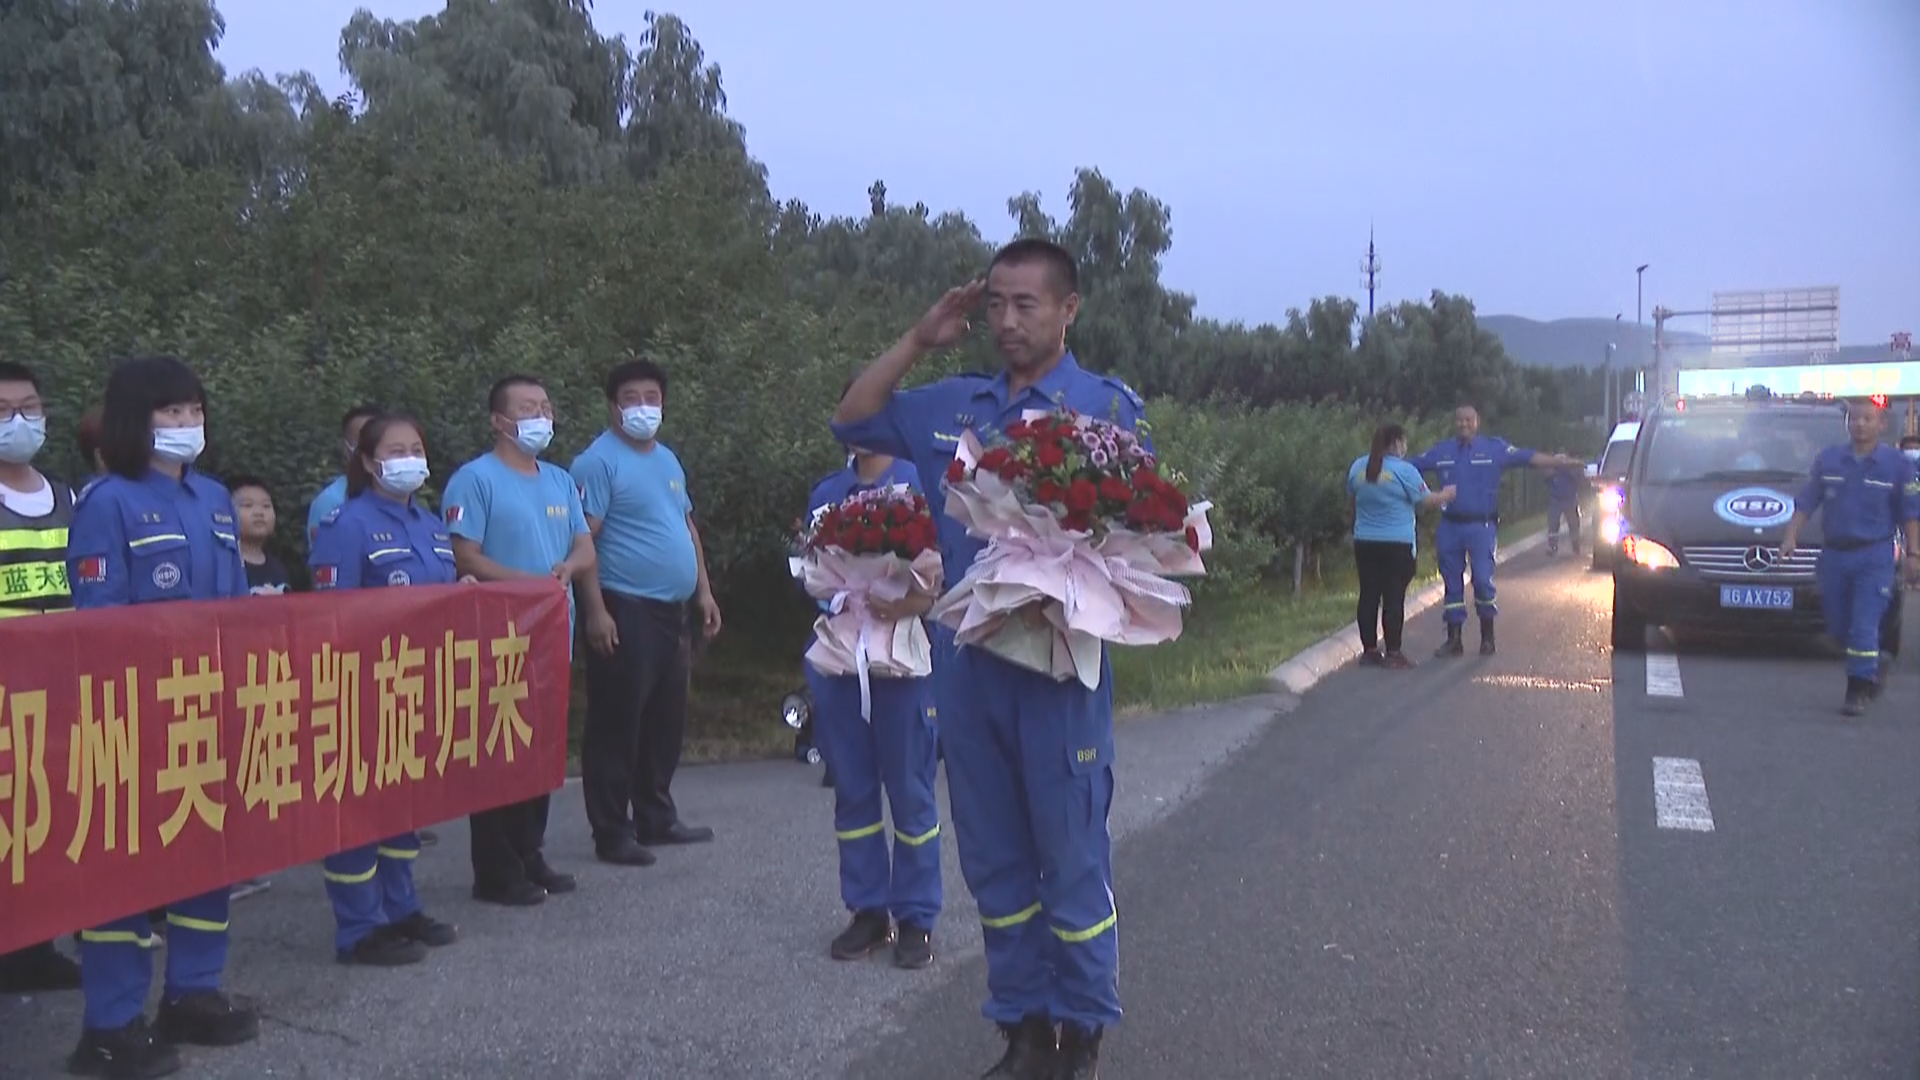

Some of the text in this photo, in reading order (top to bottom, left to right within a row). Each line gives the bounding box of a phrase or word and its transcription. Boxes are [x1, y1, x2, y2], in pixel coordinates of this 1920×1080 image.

[1732, 501, 1780, 511] BSR
[0, 620, 533, 884] 郑州英雄凯旋归来
[1077, 748, 1097, 762] BSR
